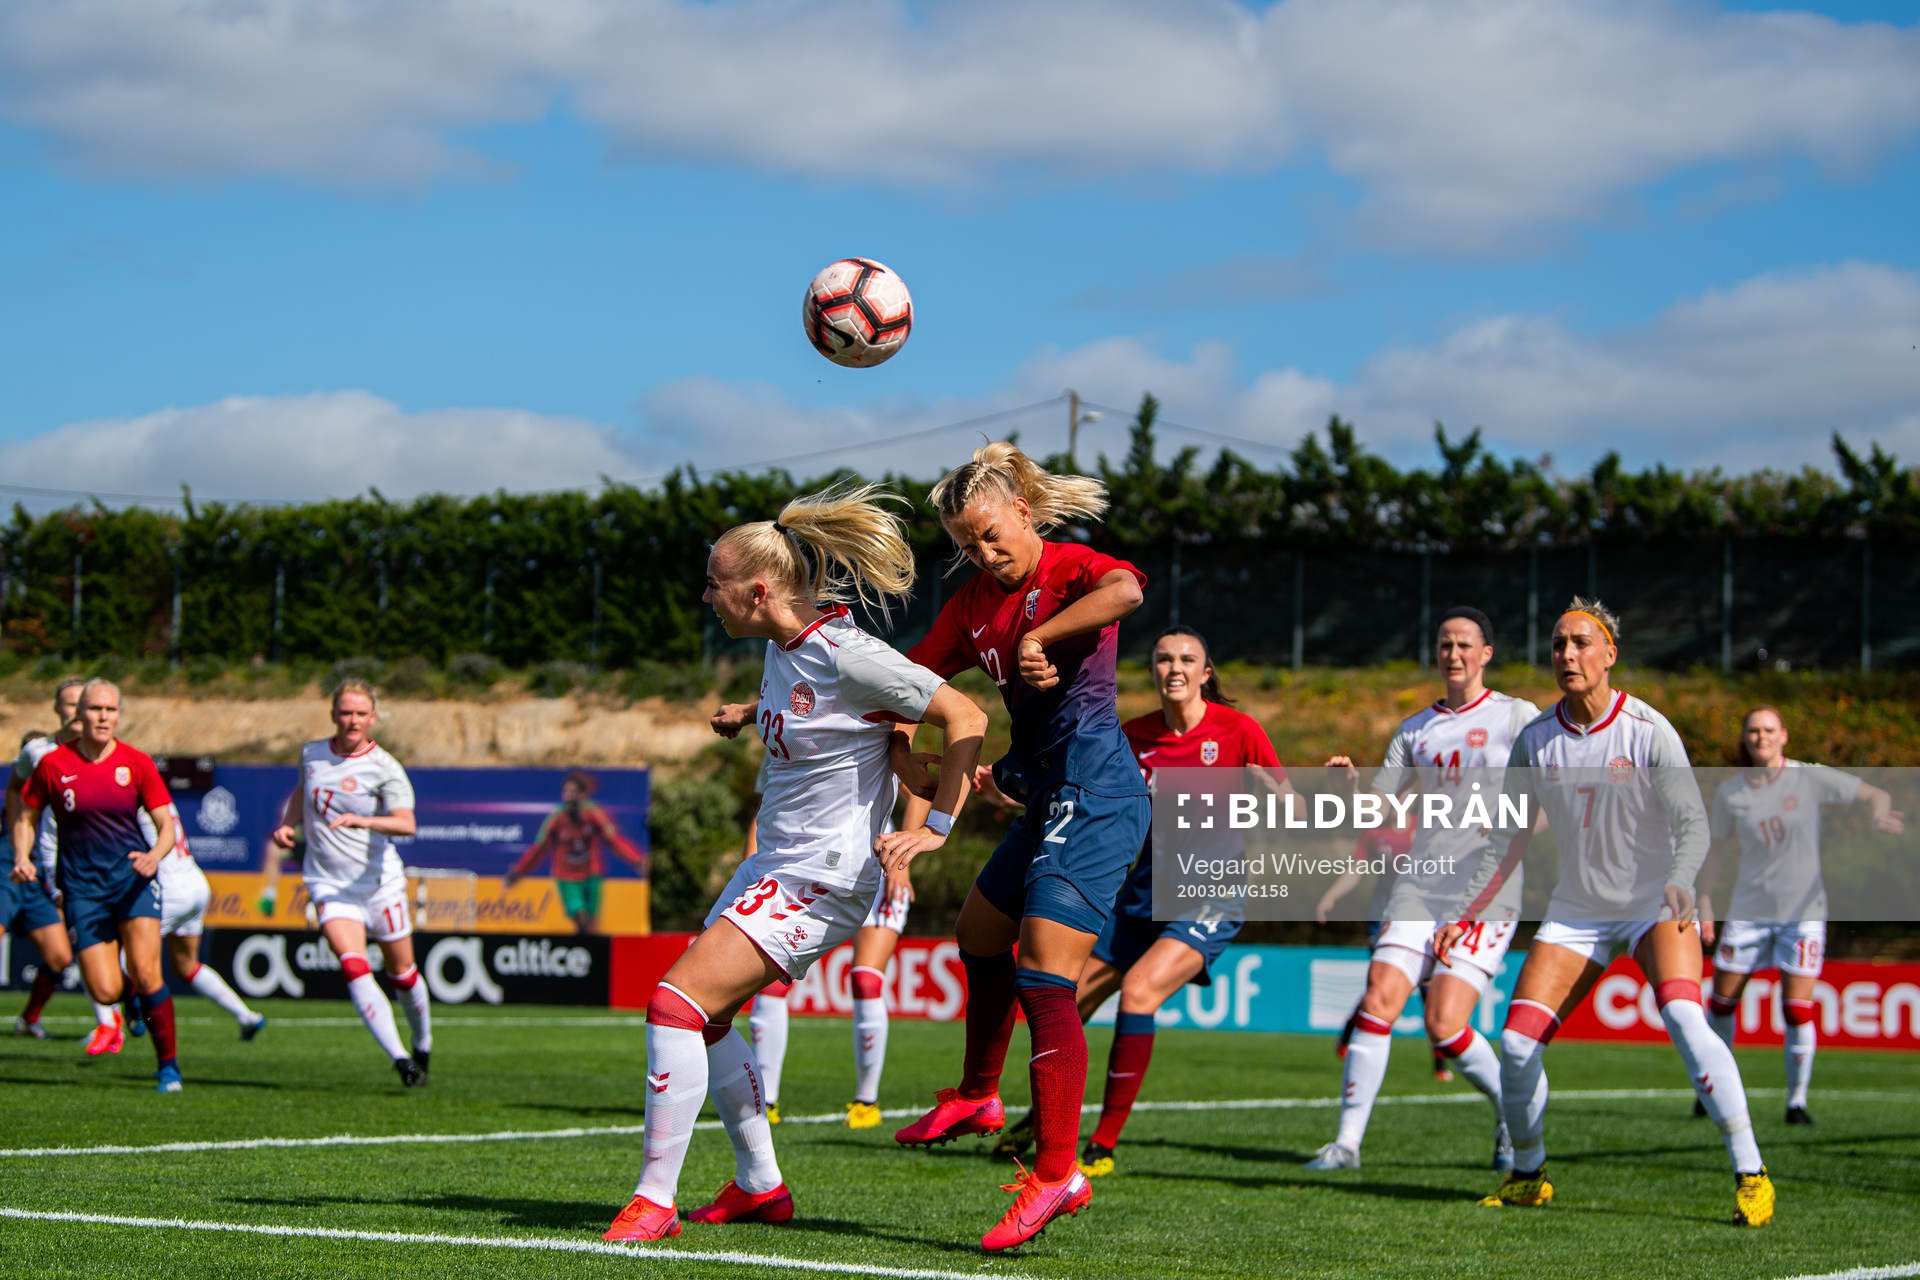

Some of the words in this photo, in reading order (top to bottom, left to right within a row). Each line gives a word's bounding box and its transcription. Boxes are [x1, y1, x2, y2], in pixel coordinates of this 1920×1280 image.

[1433, 749, 1461, 787] 14
[64, 788, 76, 811] 3
[312, 787, 334, 816] 17
[1577, 787, 1597, 829] 7
[1045, 801, 1075, 844] 22
[493, 939, 592, 977] altice
